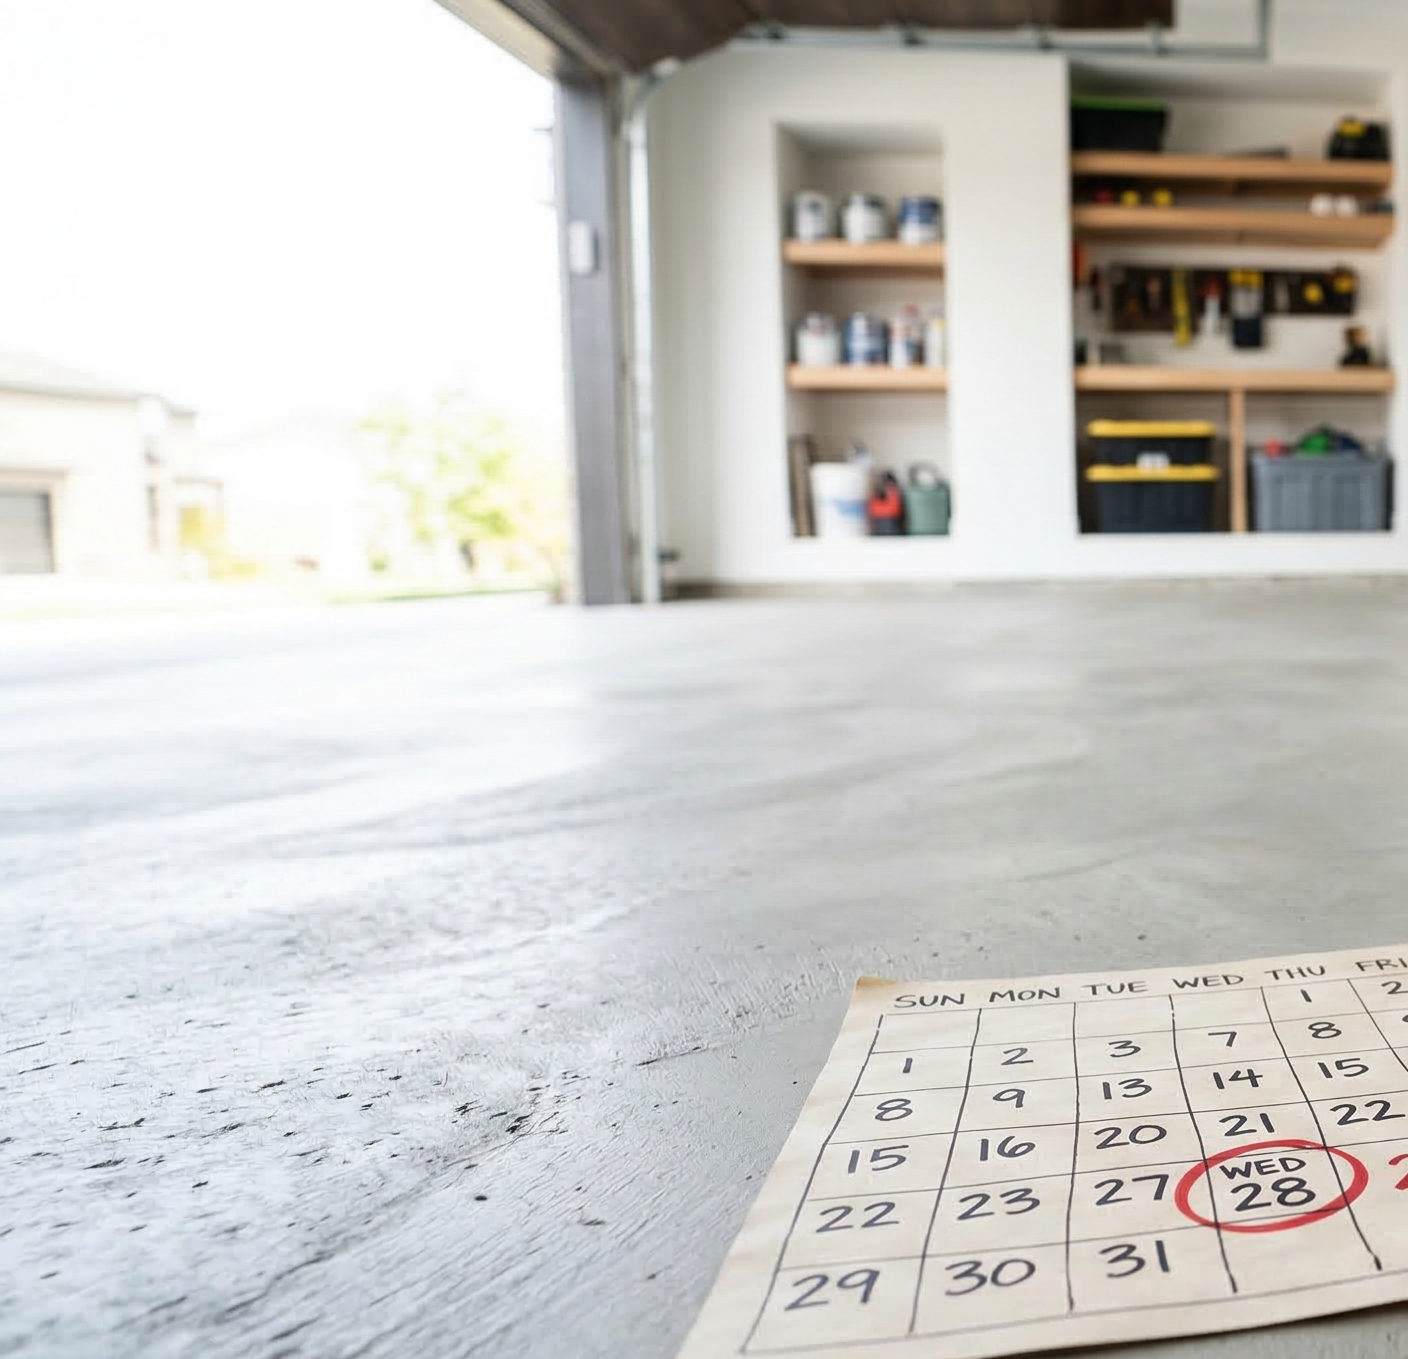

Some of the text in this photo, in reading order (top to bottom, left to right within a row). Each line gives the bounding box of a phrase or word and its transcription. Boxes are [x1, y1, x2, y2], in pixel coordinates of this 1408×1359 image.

[895, 993, 966, 1008] SUN
[989, 986, 1061, 1003] MON
[1083, 981, 1149, 996] TUE
[1172, 974, 1245, 989] WED
[1264, 966, 1326, 981] THU
[1355, 957, 1408, 972] FRI
[1300, 989, 1312, 1003] 1
[902, 1058, 914, 1074] 1
[1001, 1047, 1034, 1066] 2
[1108, 1040, 1141, 1058] 3
[1207, 1031, 1237, 1048] 7
[1307, 1021, 1342, 1039] 8
[874, 1098, 914, 1122] 8
[992, 1088, 1026, 1109] 9
[1102, 1078, 1153, 1100] 13
[1212, 1068, 1264, 1090] 14
[1317, 1057, 1369, 1079] 15
[848, 1145, 910, 1174] 15
[979, 1135, 1037, 1162] 16
[1094, 1124, 1168, 1151] 20
[1223, 1112, 1276, 1137] 21
[1331, 1100, 1406, 1126] 22
[1219, 1155, 1308, 1181] WED
[816, 1174, 1318, 1234] 22 23 27 28
[784, 1240, 1171, 1311] 29 30 31
